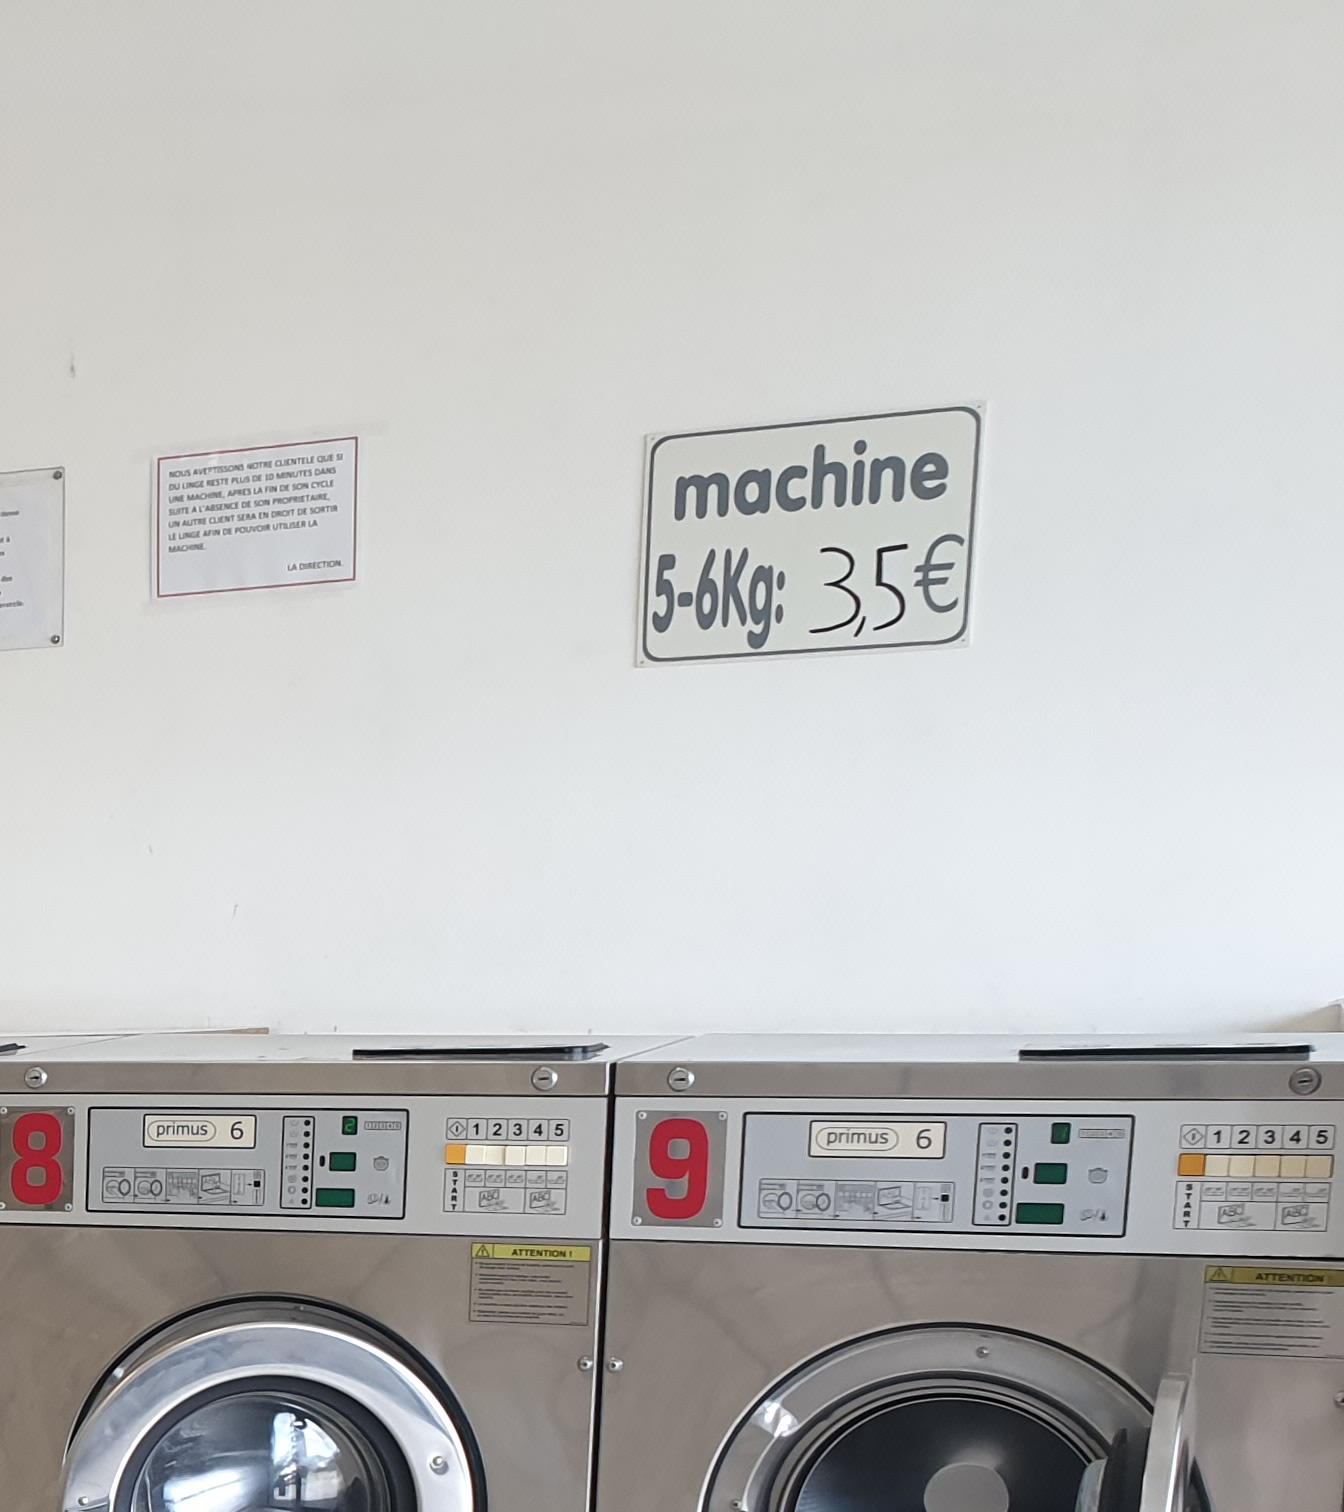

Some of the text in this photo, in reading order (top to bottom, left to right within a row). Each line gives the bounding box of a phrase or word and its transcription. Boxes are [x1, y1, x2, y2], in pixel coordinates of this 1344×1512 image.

[169, 469, 191, 478] NOUS
[275, 456, 314, 468] CLIENTELE
[317, 455, 334, 463] QUE
[336, 453, 343, 461] SI
[169, 467, 336, 491] DU LINGE RESTE PLUS DE 10 MINUTES DANS
[674, 440, 949, 521] machine
[287, 564, 297, 572] LA
[652, 534, 965, 649] 5-6Kg: 3,5€
[156, 1121, 244, 1140] primus 6
[344, 1120, 355, 1132] 2
[473, 1123, 564, 1136] 1 2 3 4 5
[826, 1128, 932, 1149] primus 6
[1213, 1130, 1329, 1144] 1 2 3 4 5
[12, 1112, 62, 1205] 8
[646, 1118, 708, 1219] 9
[1184, 1184, 1193, 1227] START
[511, 1249, 567, 1258] ATTENTION
[1256, 1273, 1324, 1282] ATTENTION
